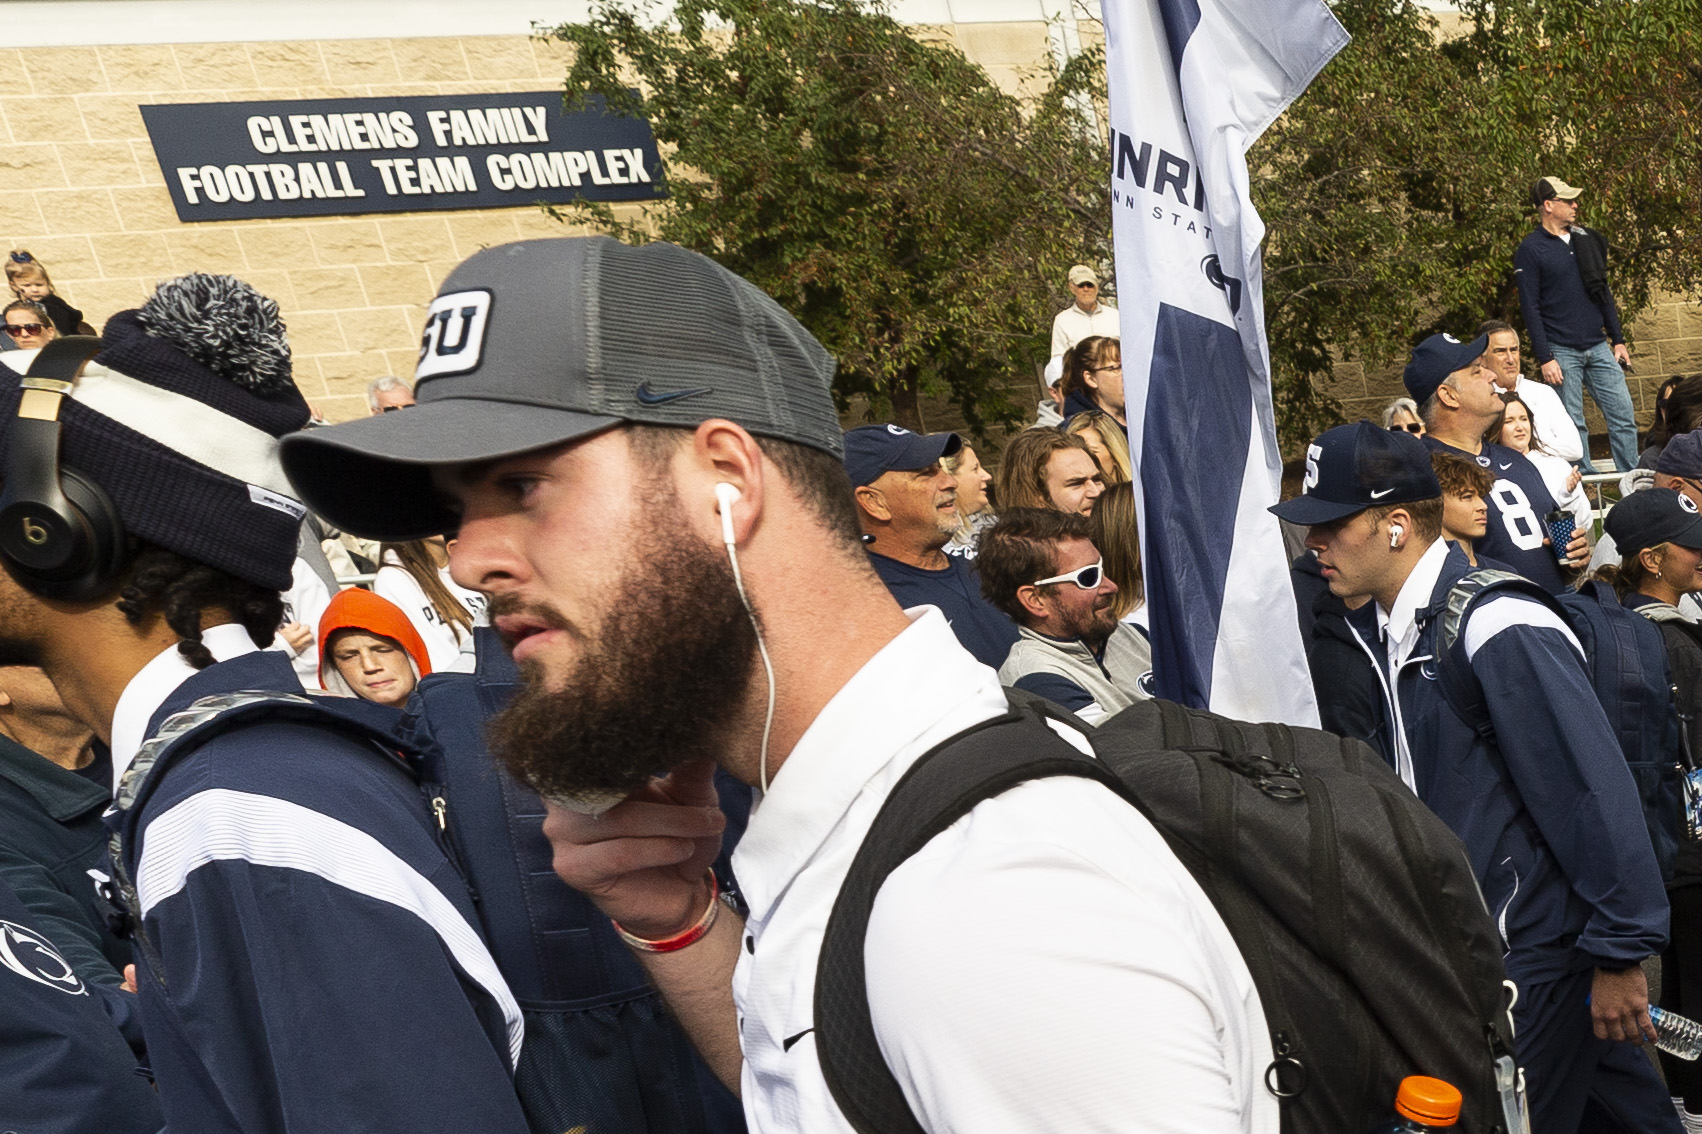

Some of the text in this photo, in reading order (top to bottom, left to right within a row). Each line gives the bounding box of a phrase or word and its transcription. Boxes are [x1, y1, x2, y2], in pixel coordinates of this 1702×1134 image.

[246, 107, 549, 154] CLEMENS FAMILY
[176, 147, 652, 205] FOOTBALL TEAM COMPLEX
[1490, 478, 1544, 551] 8
